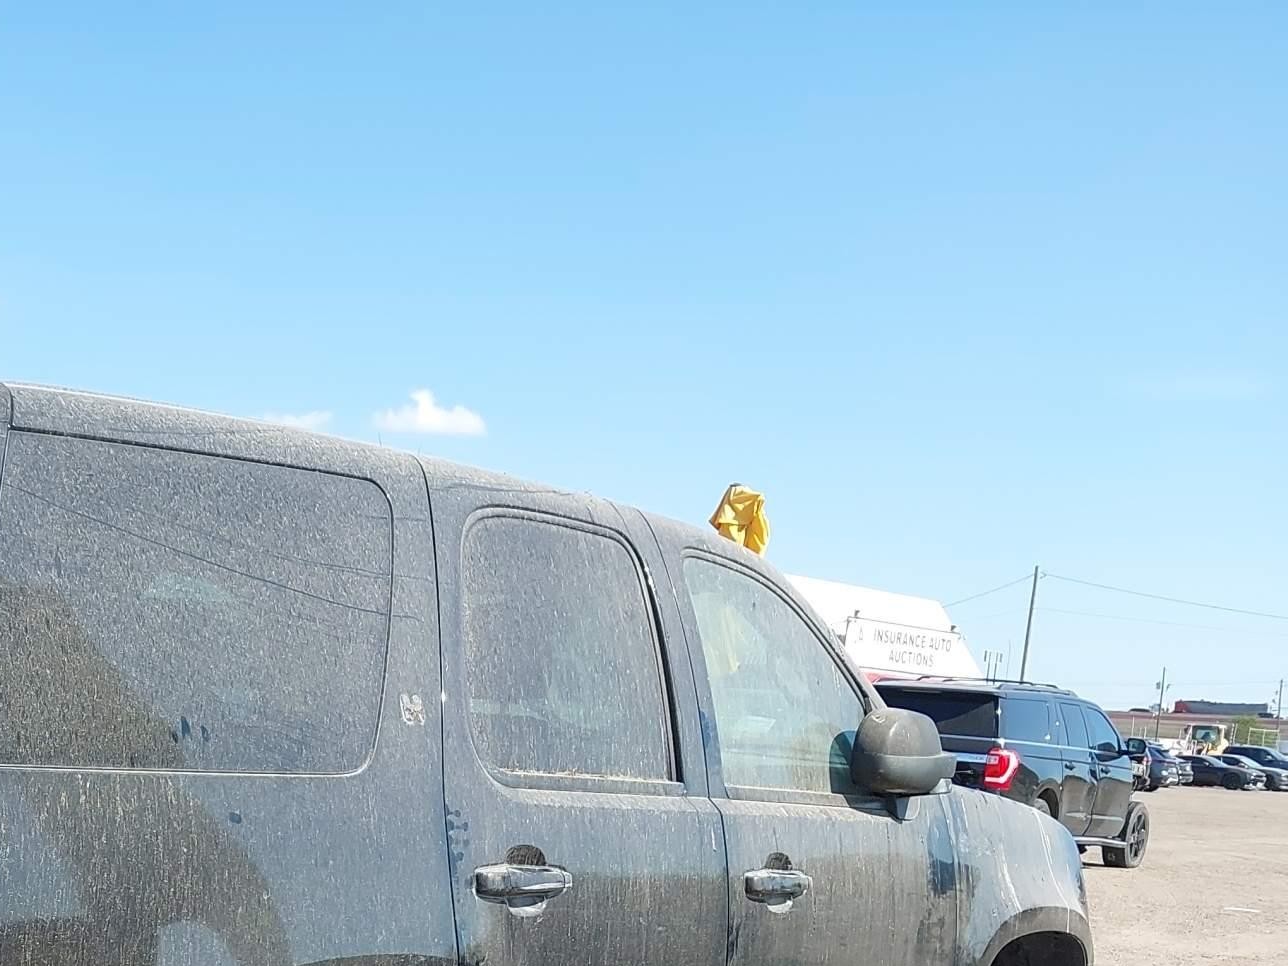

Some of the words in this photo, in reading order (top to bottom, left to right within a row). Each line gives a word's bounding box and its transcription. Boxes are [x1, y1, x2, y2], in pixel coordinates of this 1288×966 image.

[873, 627, 927, 648] INSURANCE
[928, 636, 952, 652] AUTO
[888, 649, 935, 668] AUCTIONS
